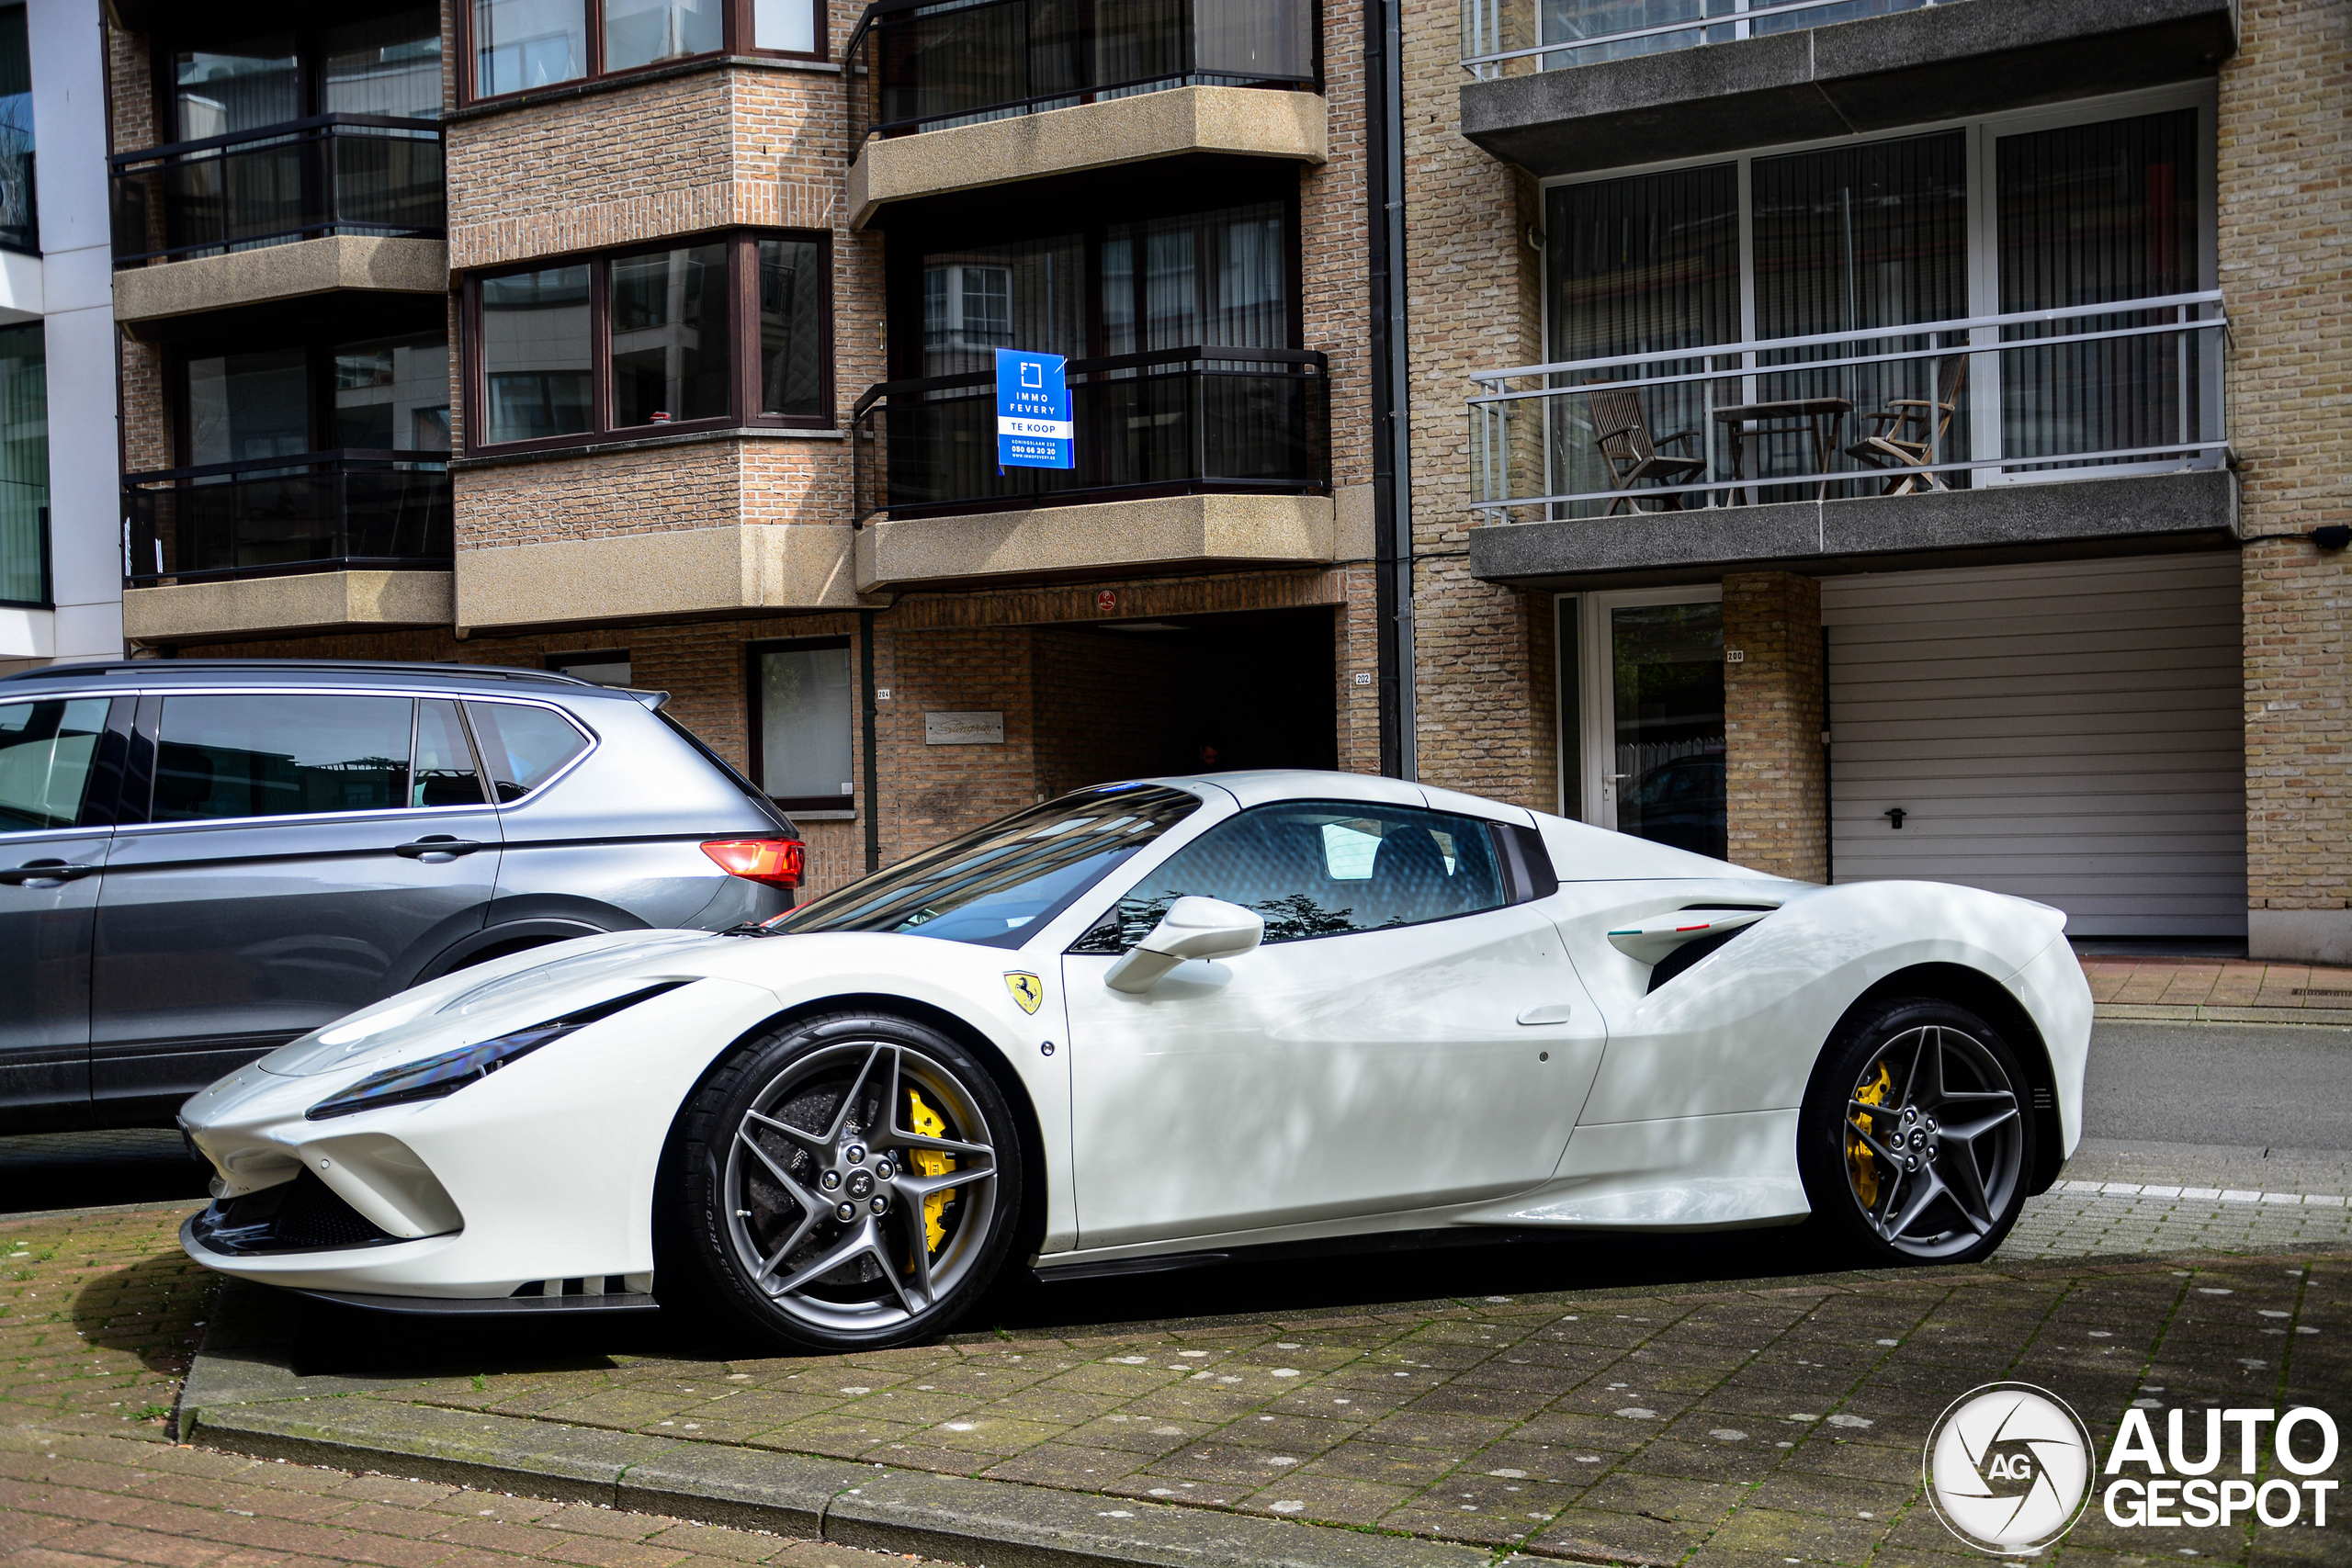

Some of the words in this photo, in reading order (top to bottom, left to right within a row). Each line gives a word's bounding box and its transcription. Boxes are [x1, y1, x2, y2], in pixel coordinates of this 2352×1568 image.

[1016, 391, 1048, 402] IMMO
[1010, 403, 1055, 414] FEVERY
[1011, 423, 1023, 431] TE
[1027, 423, 1056, 433] KOOP
[1036, 446, 1046, 455] 20
[1046, 447, 1056, 456] 20
[1357, 675, 1369, 683] 202
[935, 719, 993, 736] Stingray
[706, 1210, 722, 1255] ZR20
